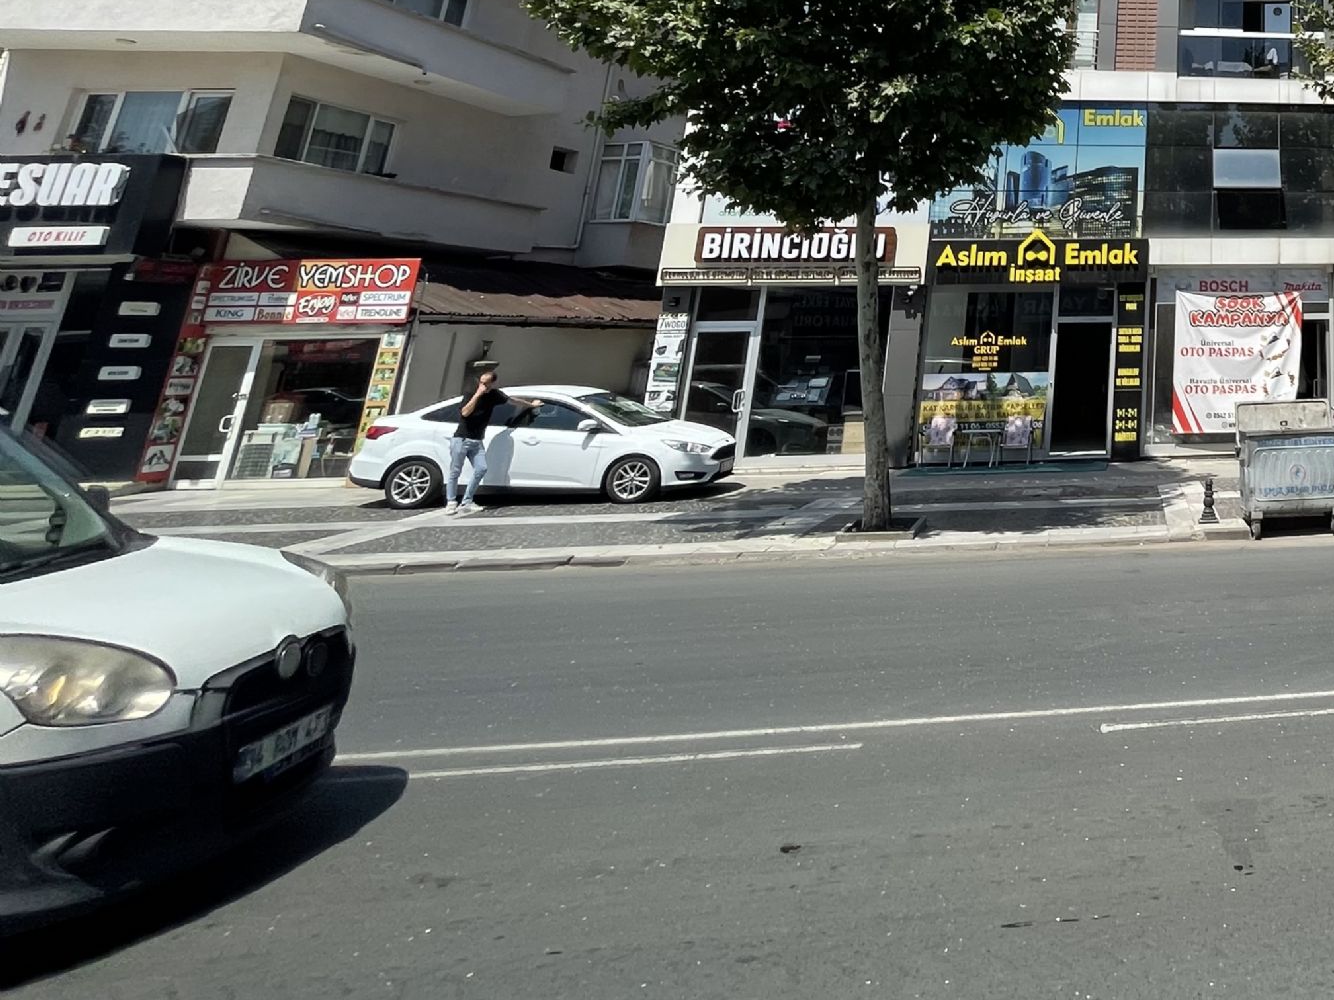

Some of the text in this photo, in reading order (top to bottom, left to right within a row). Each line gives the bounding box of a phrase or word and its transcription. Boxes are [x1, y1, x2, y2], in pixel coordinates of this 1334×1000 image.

[1083, 109, 1145, 127] Emlak
[936, 243, 1139, 266] Aslım Emlak
[219, 262, 411, 288] ZİRVE YEMSHOP
[1200, 280, 1323, 292] BOSCH makita
[363, 293, 407, 301] SPECTRUM
[214, 309, 245, 317] KING
[1189, 309, 1290, 327] KAMPANYA
[951, 335, 1027, 346] Aslım Emlak
[974, 345, 1000, 354] GRUP
[1180, 347, 1255, 357] OTO PASPAS
[1185, 385, 1257, 395] OTO PASPAS
